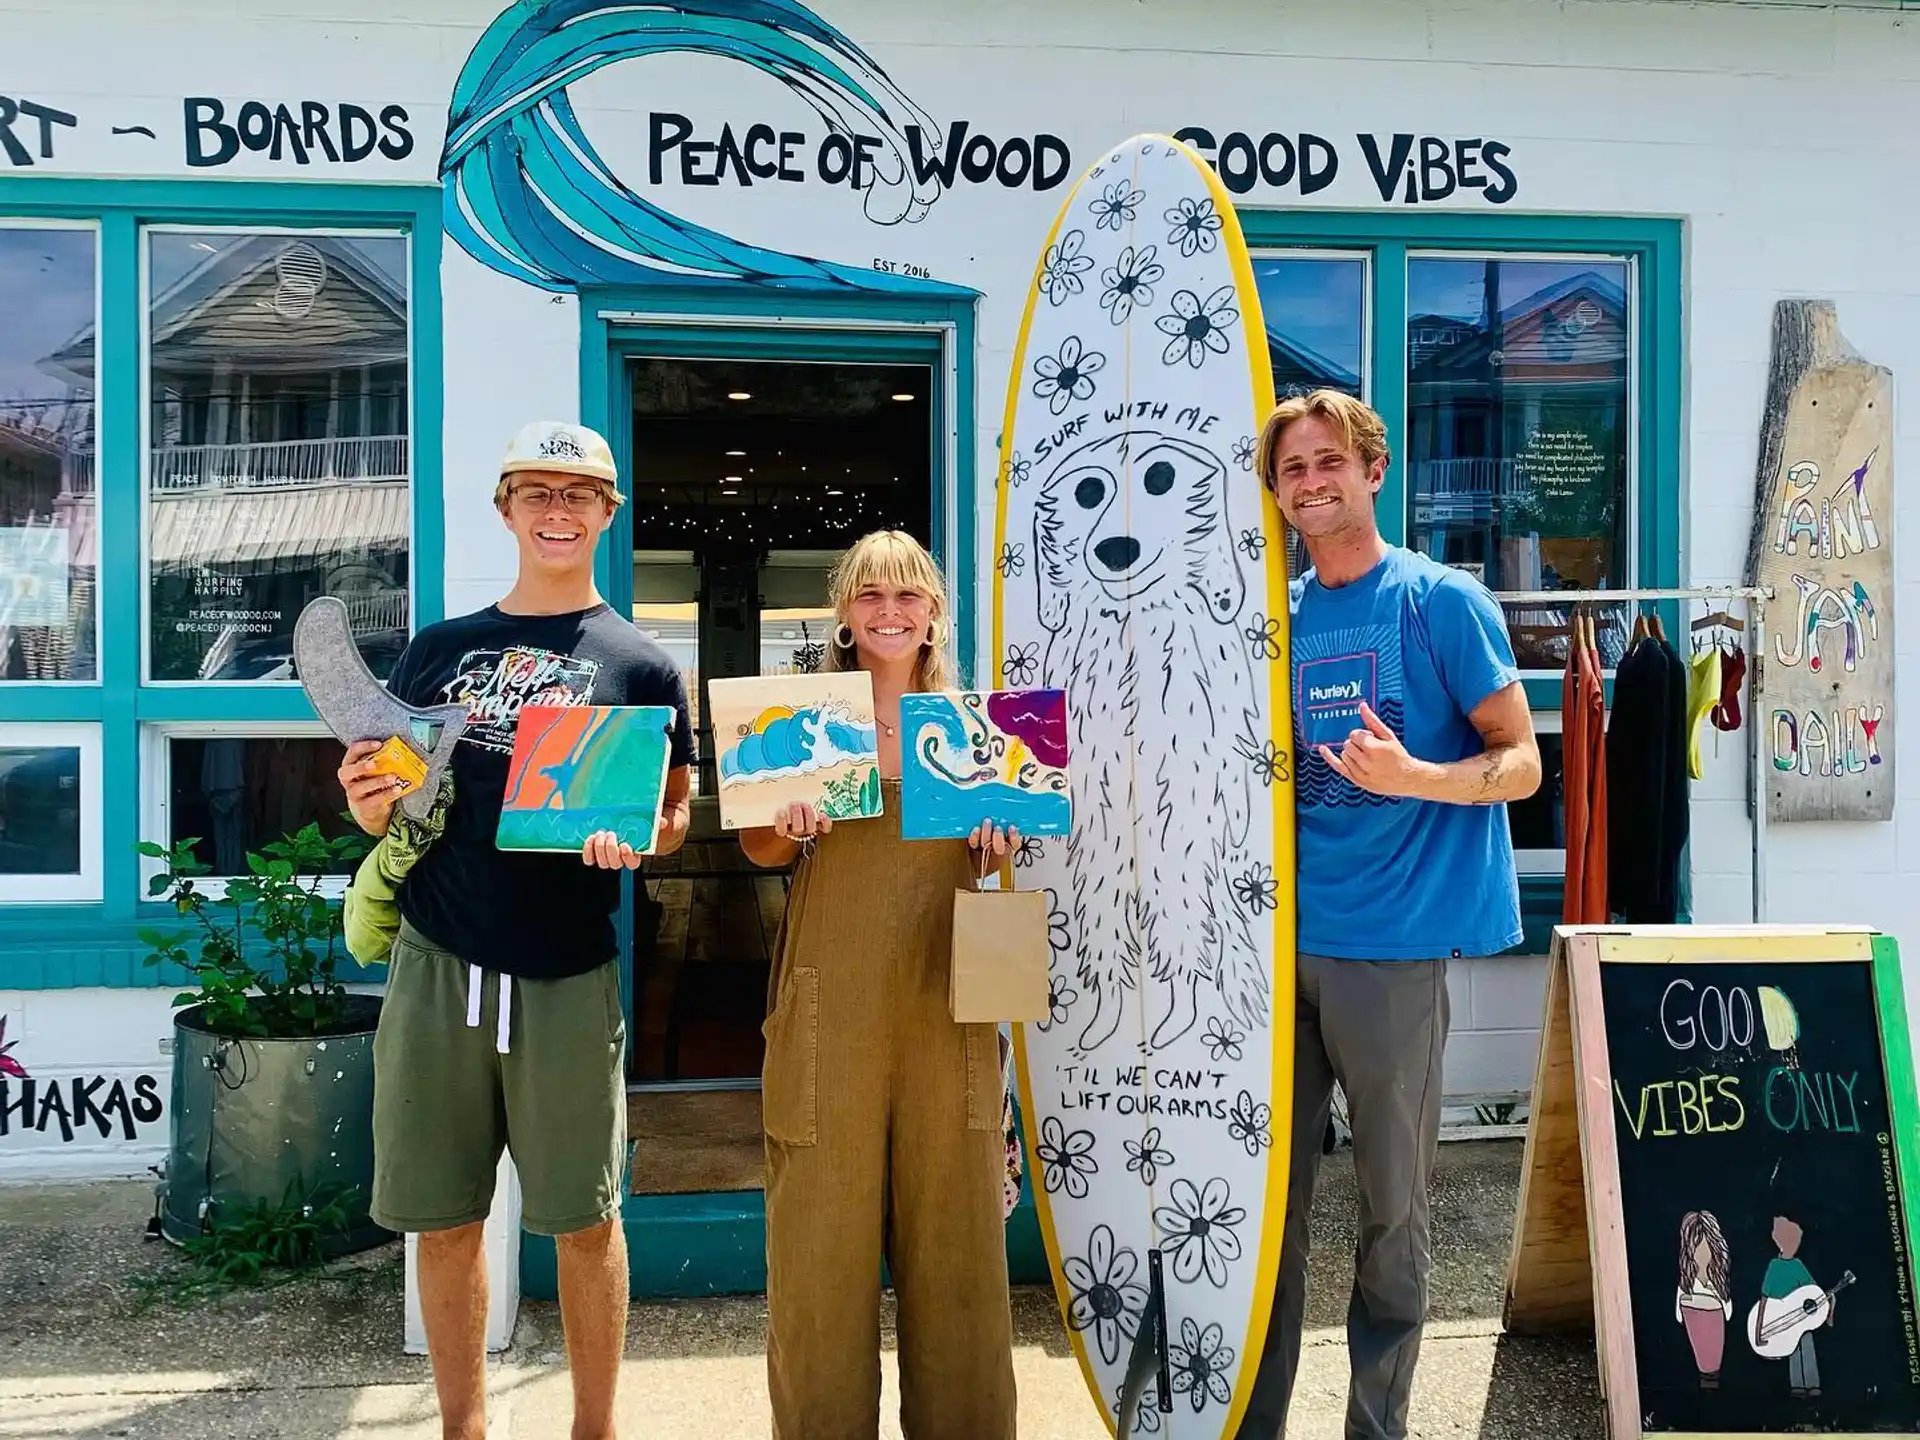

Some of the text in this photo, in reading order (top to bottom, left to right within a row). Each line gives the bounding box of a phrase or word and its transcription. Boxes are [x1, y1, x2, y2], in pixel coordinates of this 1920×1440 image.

[184, 97, 414, 167] BOARDS
[649, 112, 1070, 191] PEACE OF WOOD
[873, 258, 930, 278] EST 2016
[1034, 401, 1220, 465] SURF WITH ME
[1774, 445, 1881, 559] PAINT
[194, 586, 243, 596] HAPPILY
[195, 577, 243, 587] SURFING
[1774, 573, 1879, 674] JAM
[1310, 684, 1351, 701] Hurley
[1772, 705, 1884, 777] DAILY
[1660, 978, 1800, 1051] GOOD
[1061, 1091, 1227, 1120] LIFT OUR ARMS
[1116, 1065, 1147, 1086] WE
[1154, 1069, 1228, 1089] CAN'T
[1614, 1066, 1861, 1140] VIBES ONLY
